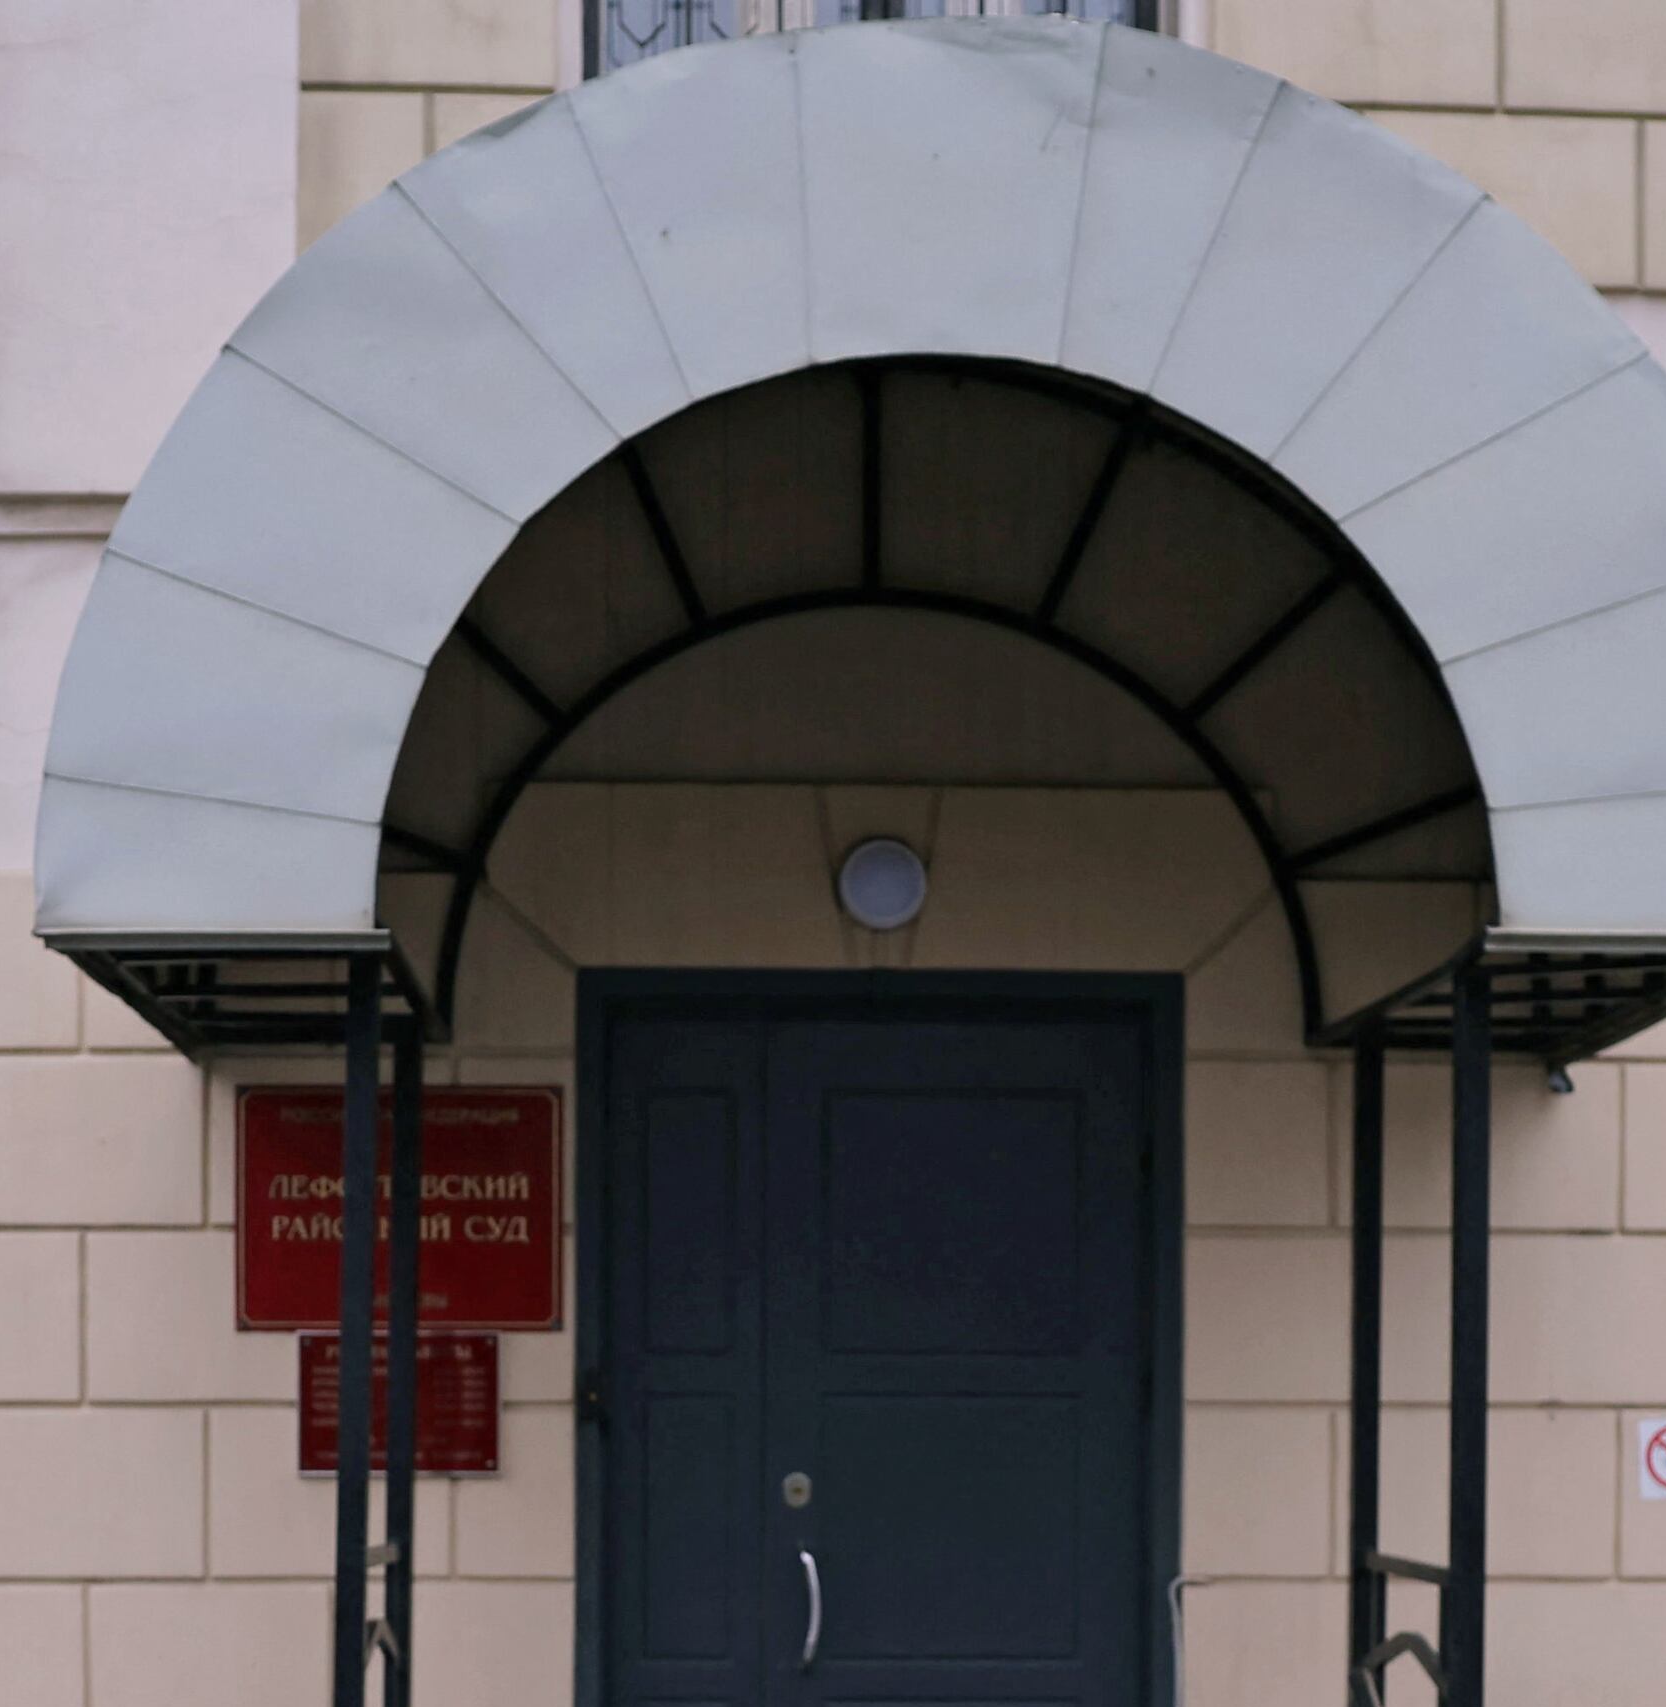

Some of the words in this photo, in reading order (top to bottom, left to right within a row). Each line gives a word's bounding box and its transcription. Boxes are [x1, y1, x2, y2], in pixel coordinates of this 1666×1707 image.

[268, 1172, 529, 1200] ЛЕФТВСКИЙ
[271, 1213, 451, 1241] РАЙНЙ
[463, 1215, 530, 1243] СУД
